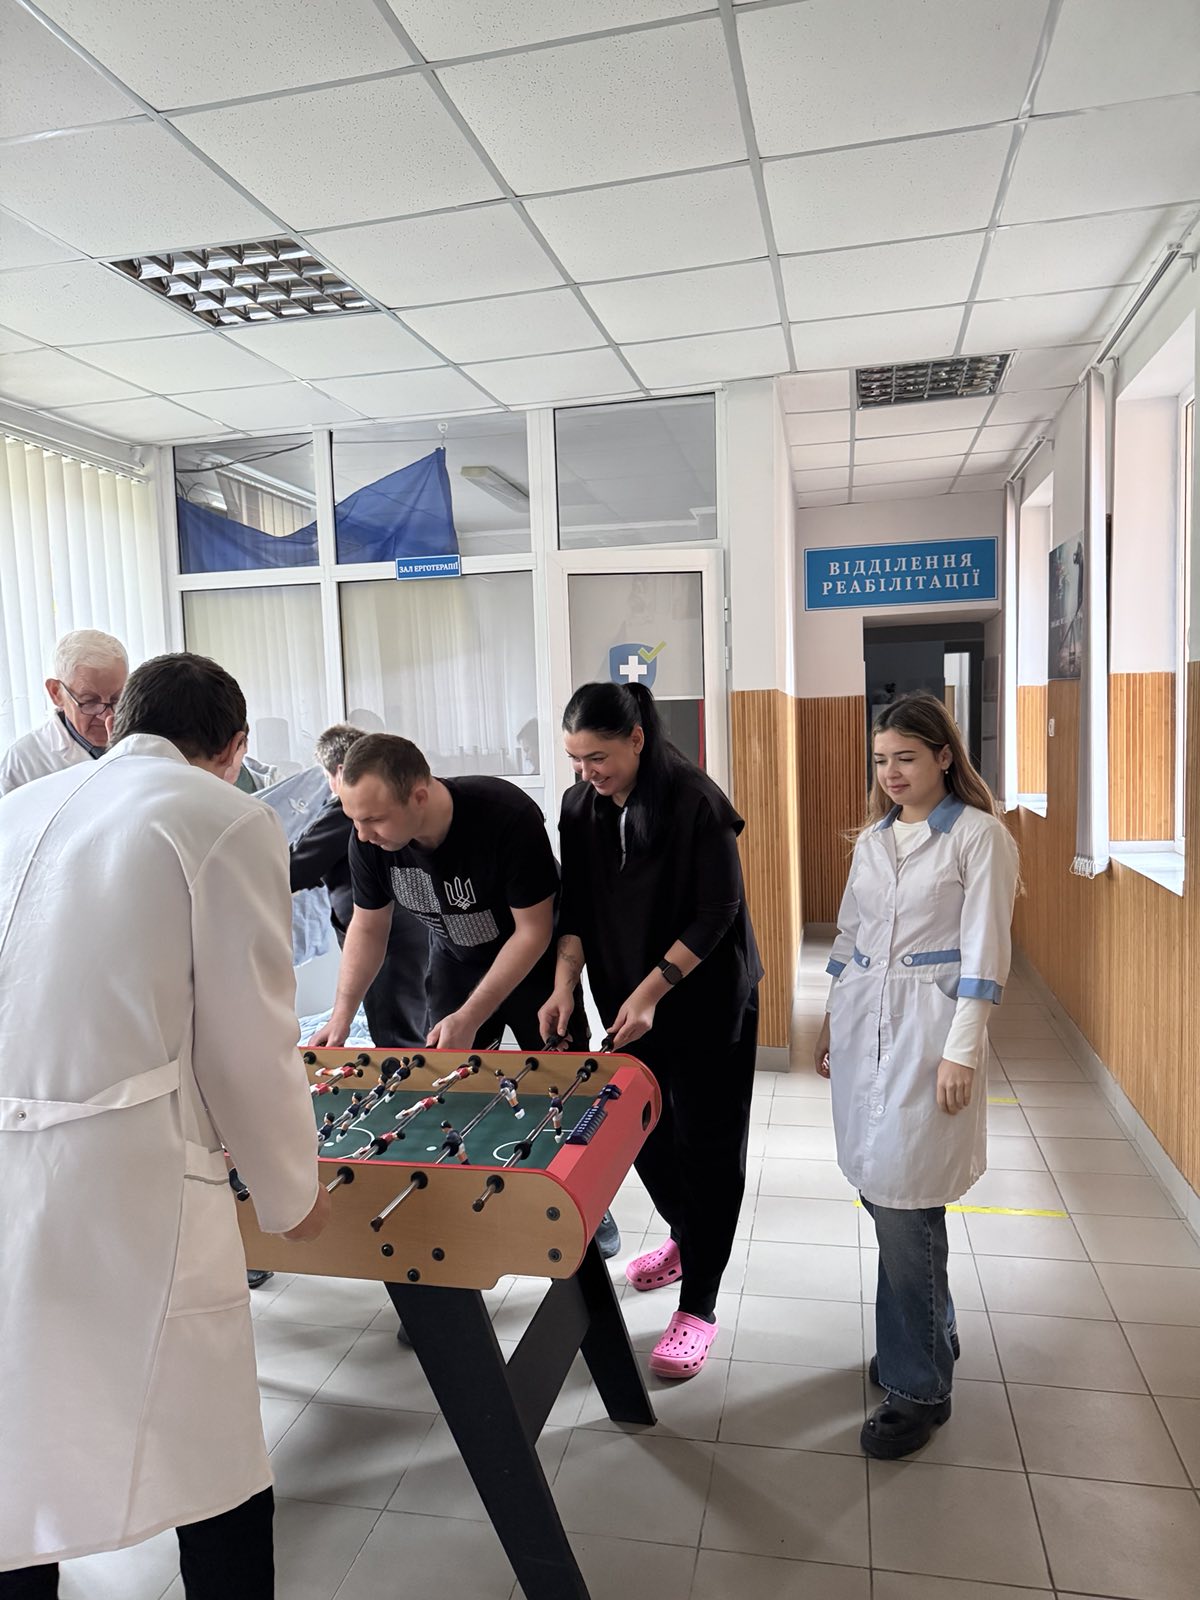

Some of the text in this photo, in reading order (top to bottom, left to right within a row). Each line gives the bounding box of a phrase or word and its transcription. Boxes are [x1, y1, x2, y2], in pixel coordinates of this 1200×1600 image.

[399, 562, 459, 573] ЗАЛ ЕРГОТЕРАПІЇ
[829, 553, 972, 576] ВІДДІЛЕННЯ
[822, 569, 981, 596] РЕАБІЛІТАЦІЇ
